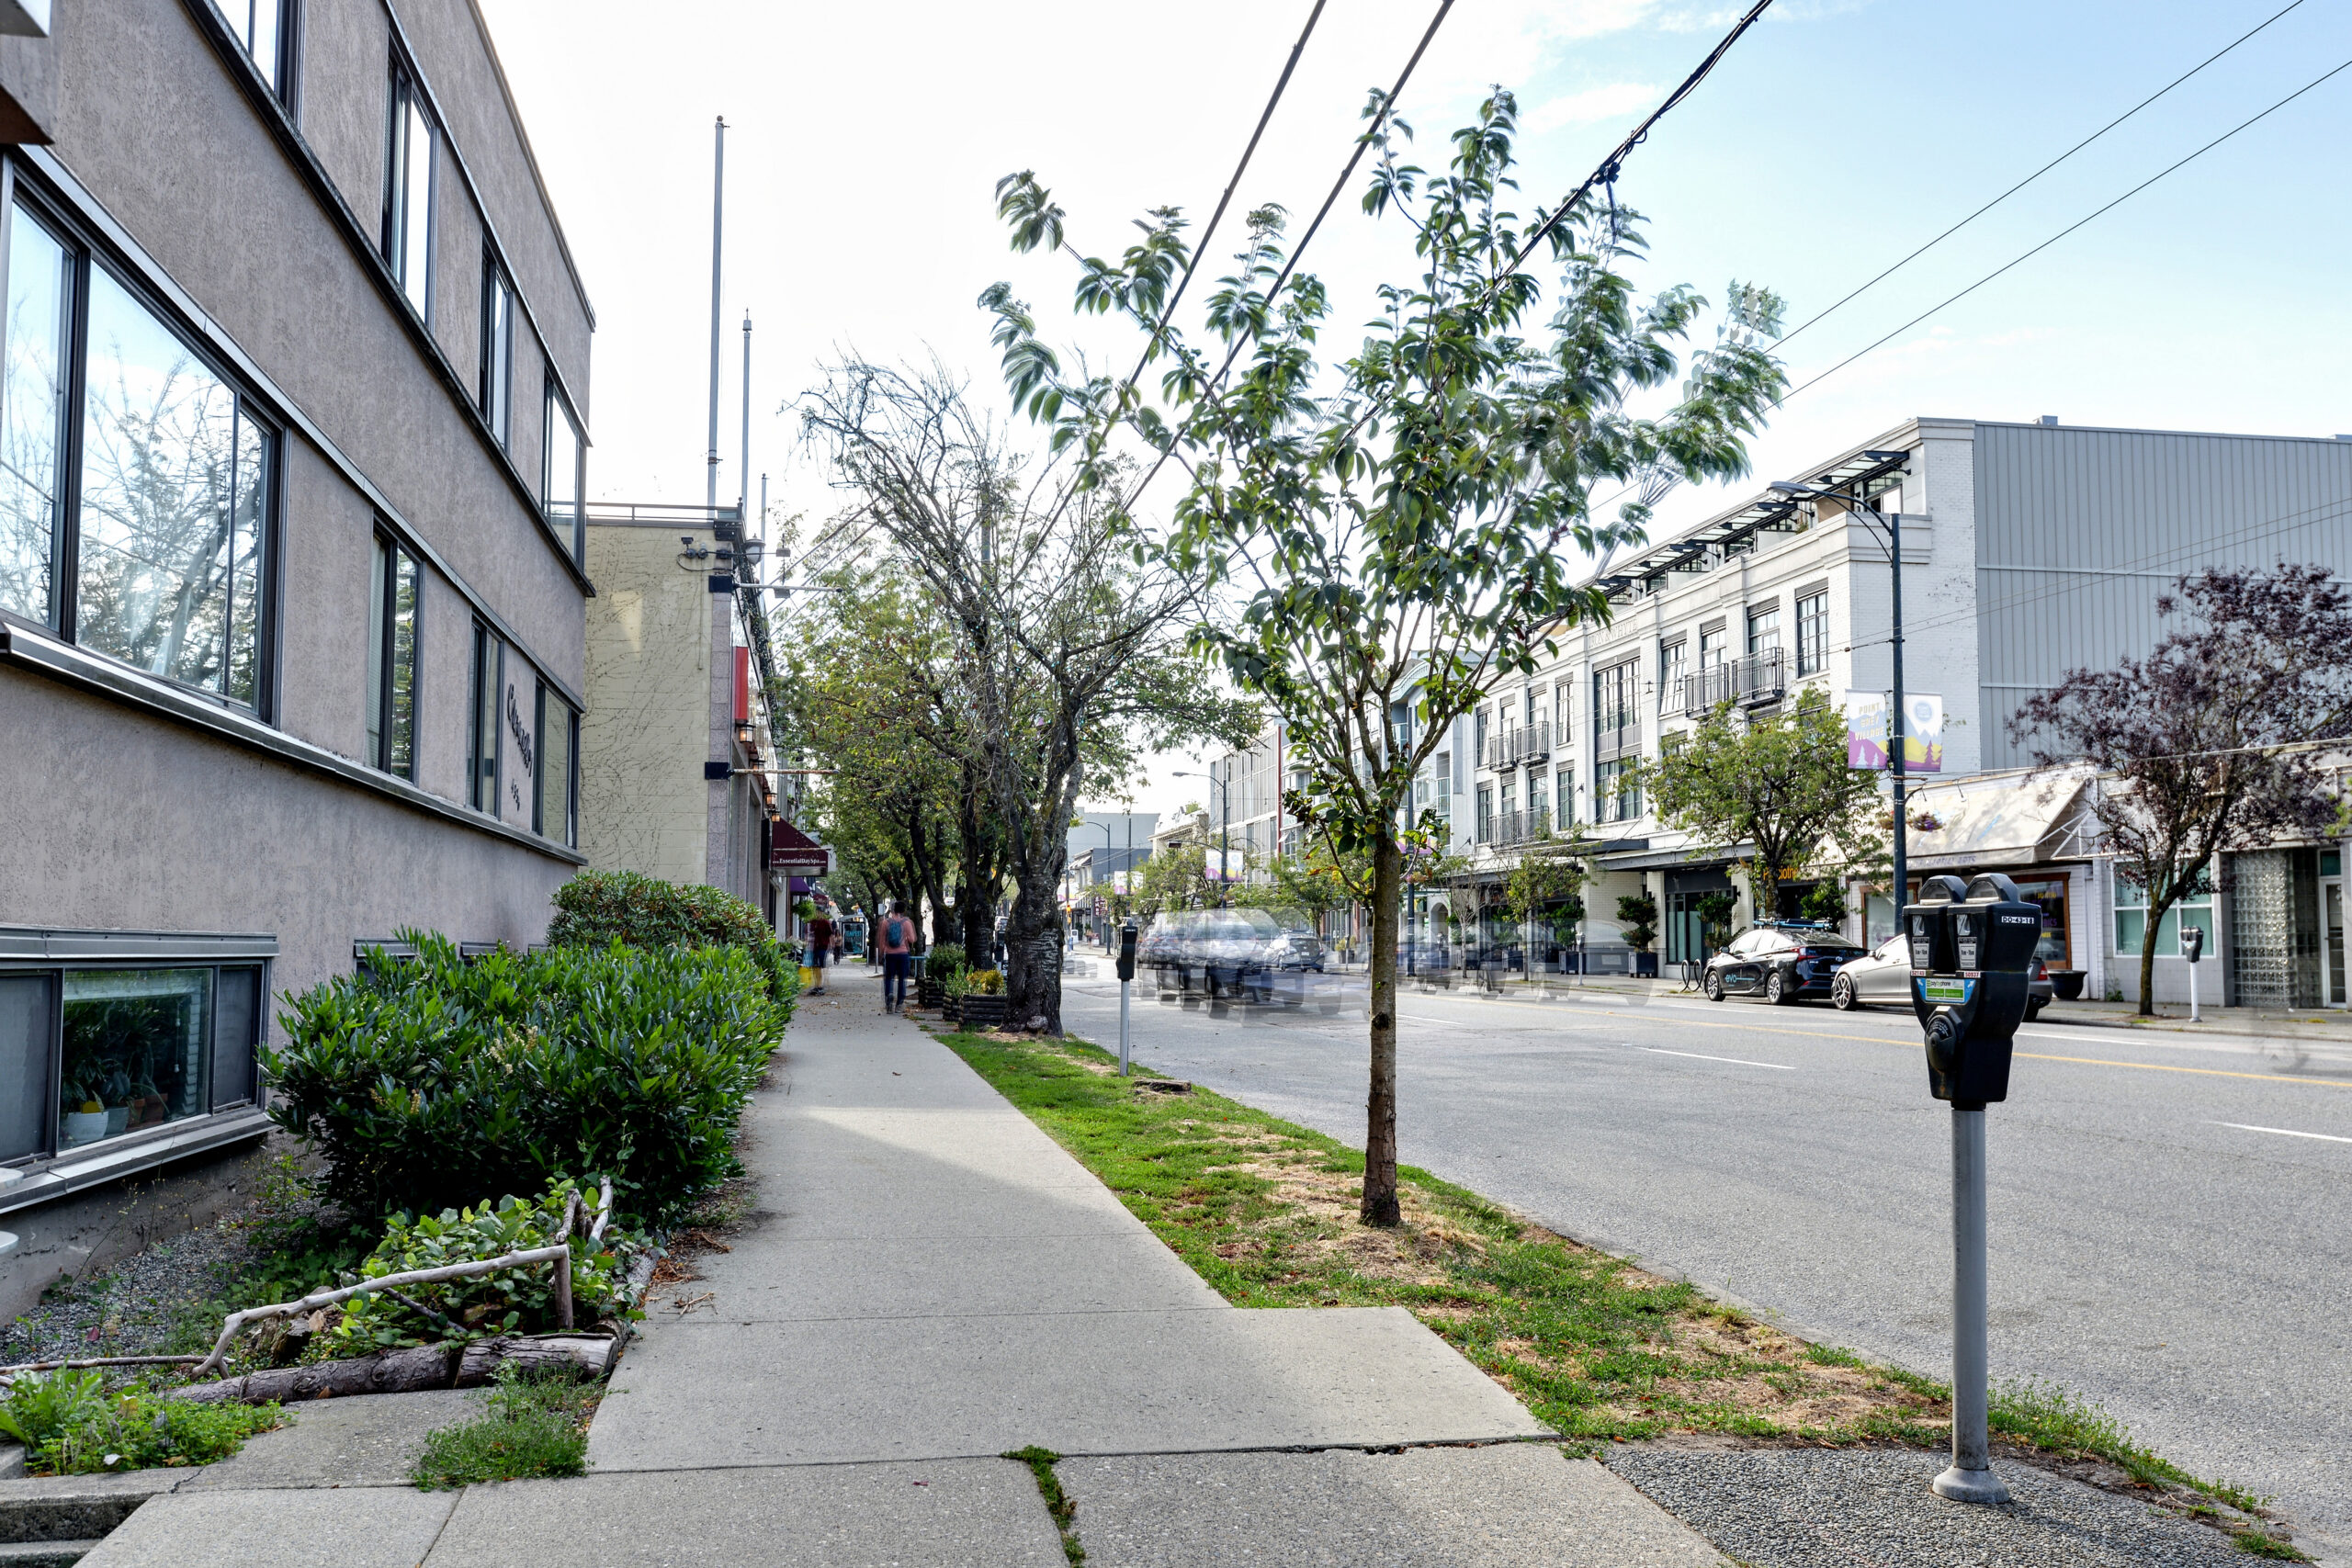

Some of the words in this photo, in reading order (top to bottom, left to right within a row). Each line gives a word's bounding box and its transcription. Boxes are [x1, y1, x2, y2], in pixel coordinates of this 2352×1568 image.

[1611, 618, 1638, 641] WHYTE
[1859, 703, 1881, 715] POINT
[1855, 727, 1884, 741] VILLAGE
